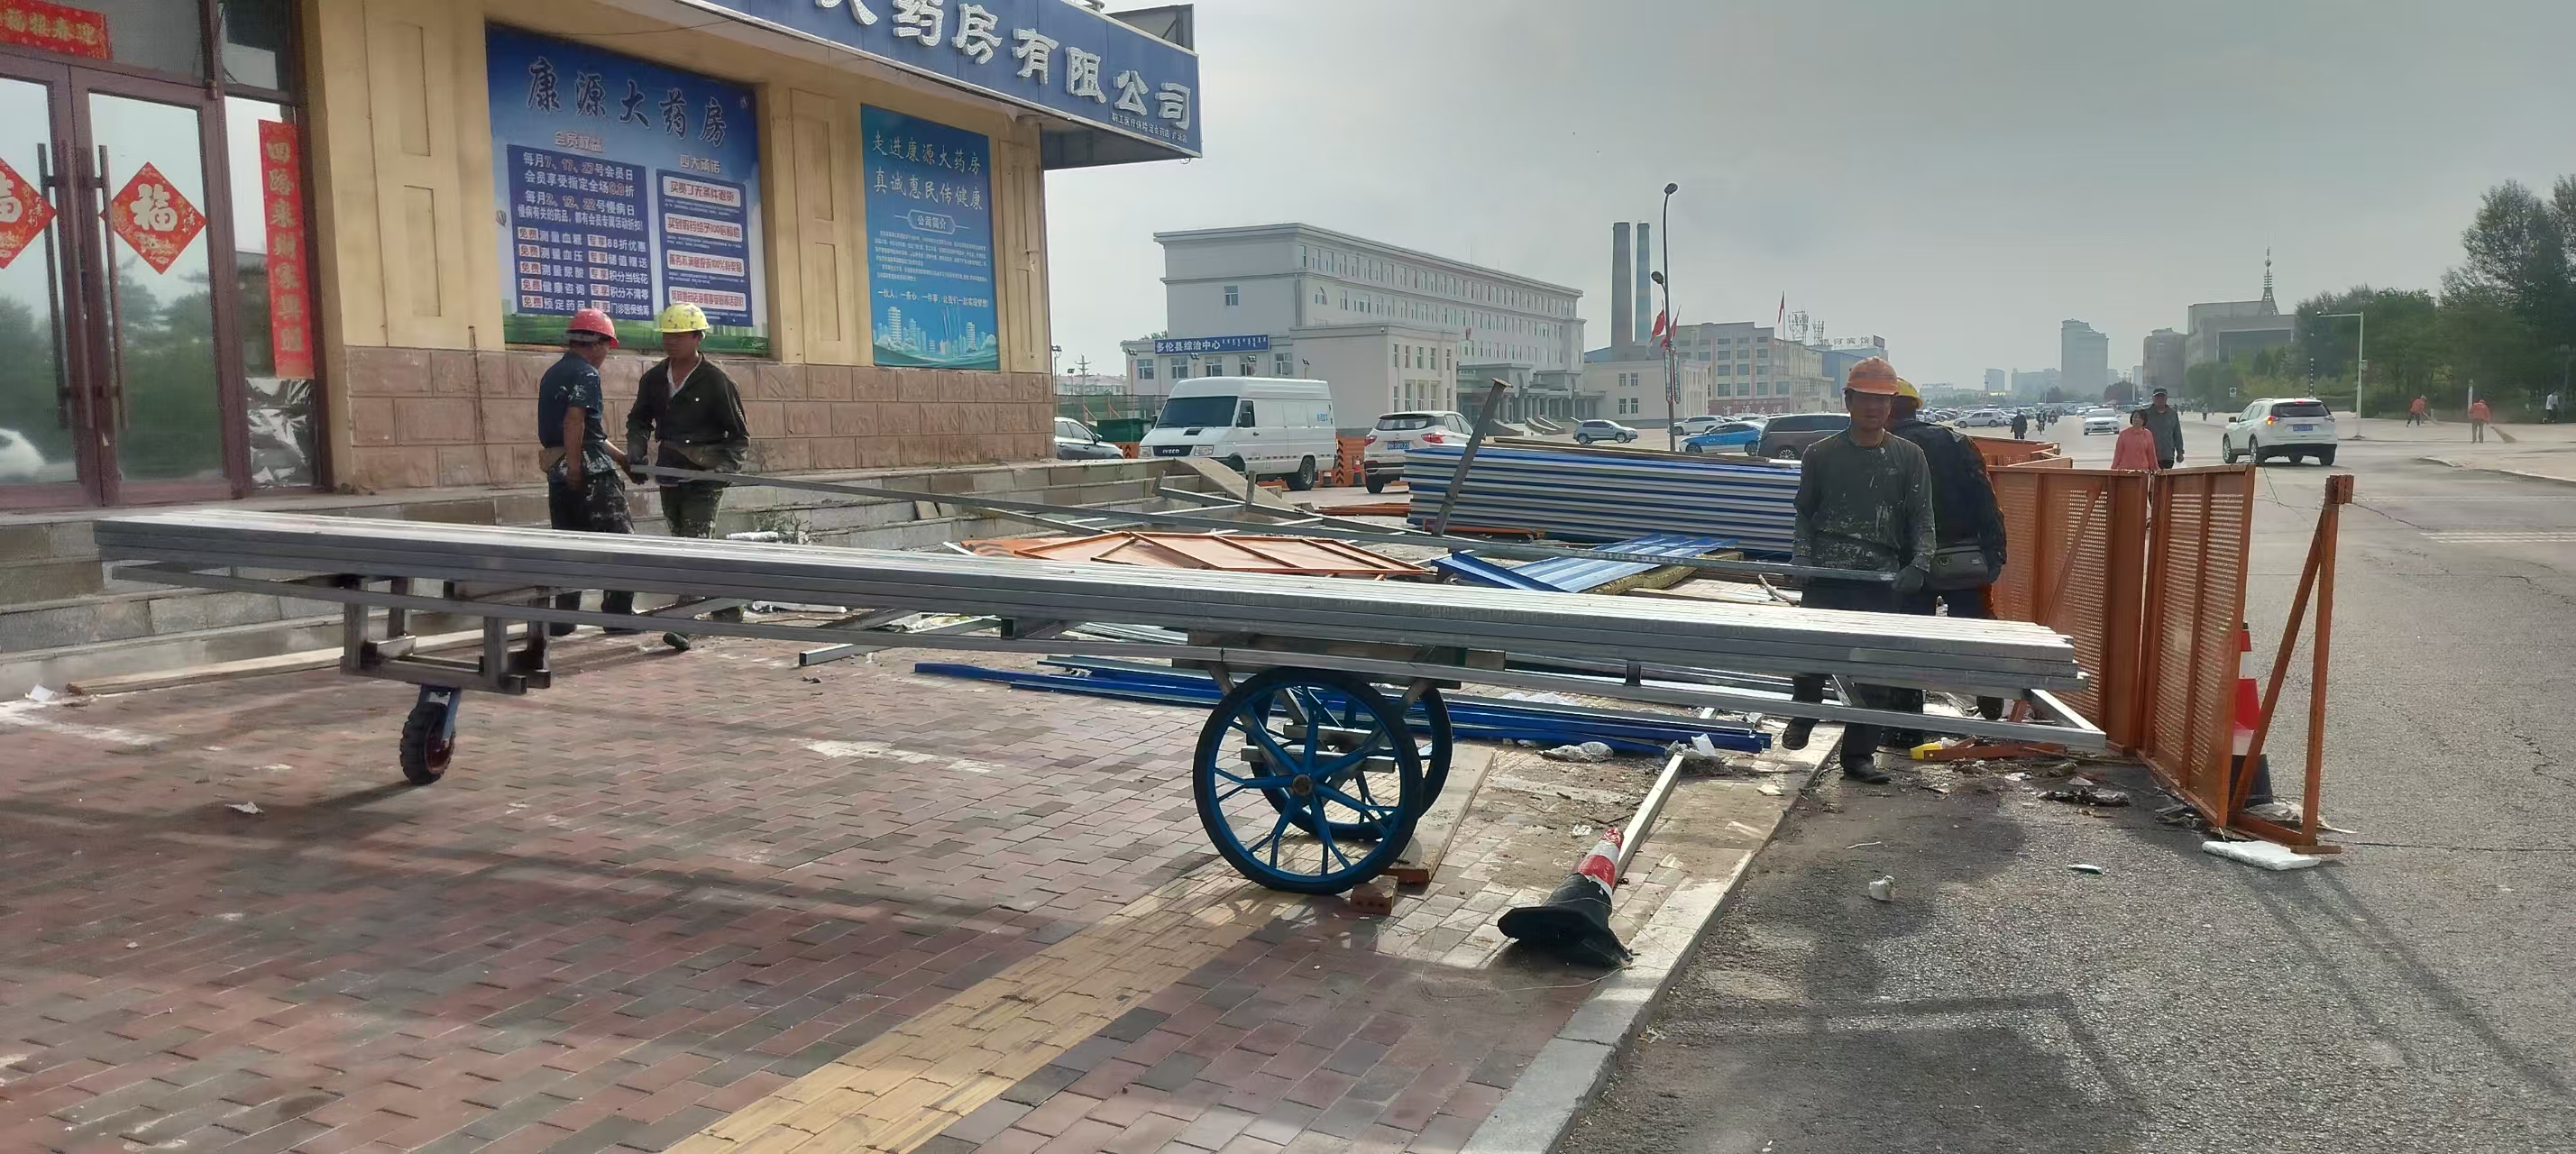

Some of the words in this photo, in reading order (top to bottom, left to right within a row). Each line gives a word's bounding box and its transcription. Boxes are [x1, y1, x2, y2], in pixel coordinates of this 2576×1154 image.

[527, 56, 727, 148] 康源大药房
[872, 131, 981, 176] 走进康源大药房
[680, 154, 721, 174] 四大承诺
[874, 167, 983, 210] 真诚惠民传健康
[130, 183, 178, 232] 福
[917, 215, 946, 230] 公司简介
[519, 228, 538, 239] 免费
[540, 230, 582, 245] 测量血糖
[608, 238, 646, 252] 88折优惠
[520, 245, 539, 257] 免费
[541, 247, 583, 262] 测量血压
[521, 262, 540, 274] 免费
[610, 270, 648, 284] 积分当钱花
[522, 279, 541, 290] 免费
[543, 281, 585, 296] 健康咨询
[1156, 340, 1221, 353] 多伦县综治中心
